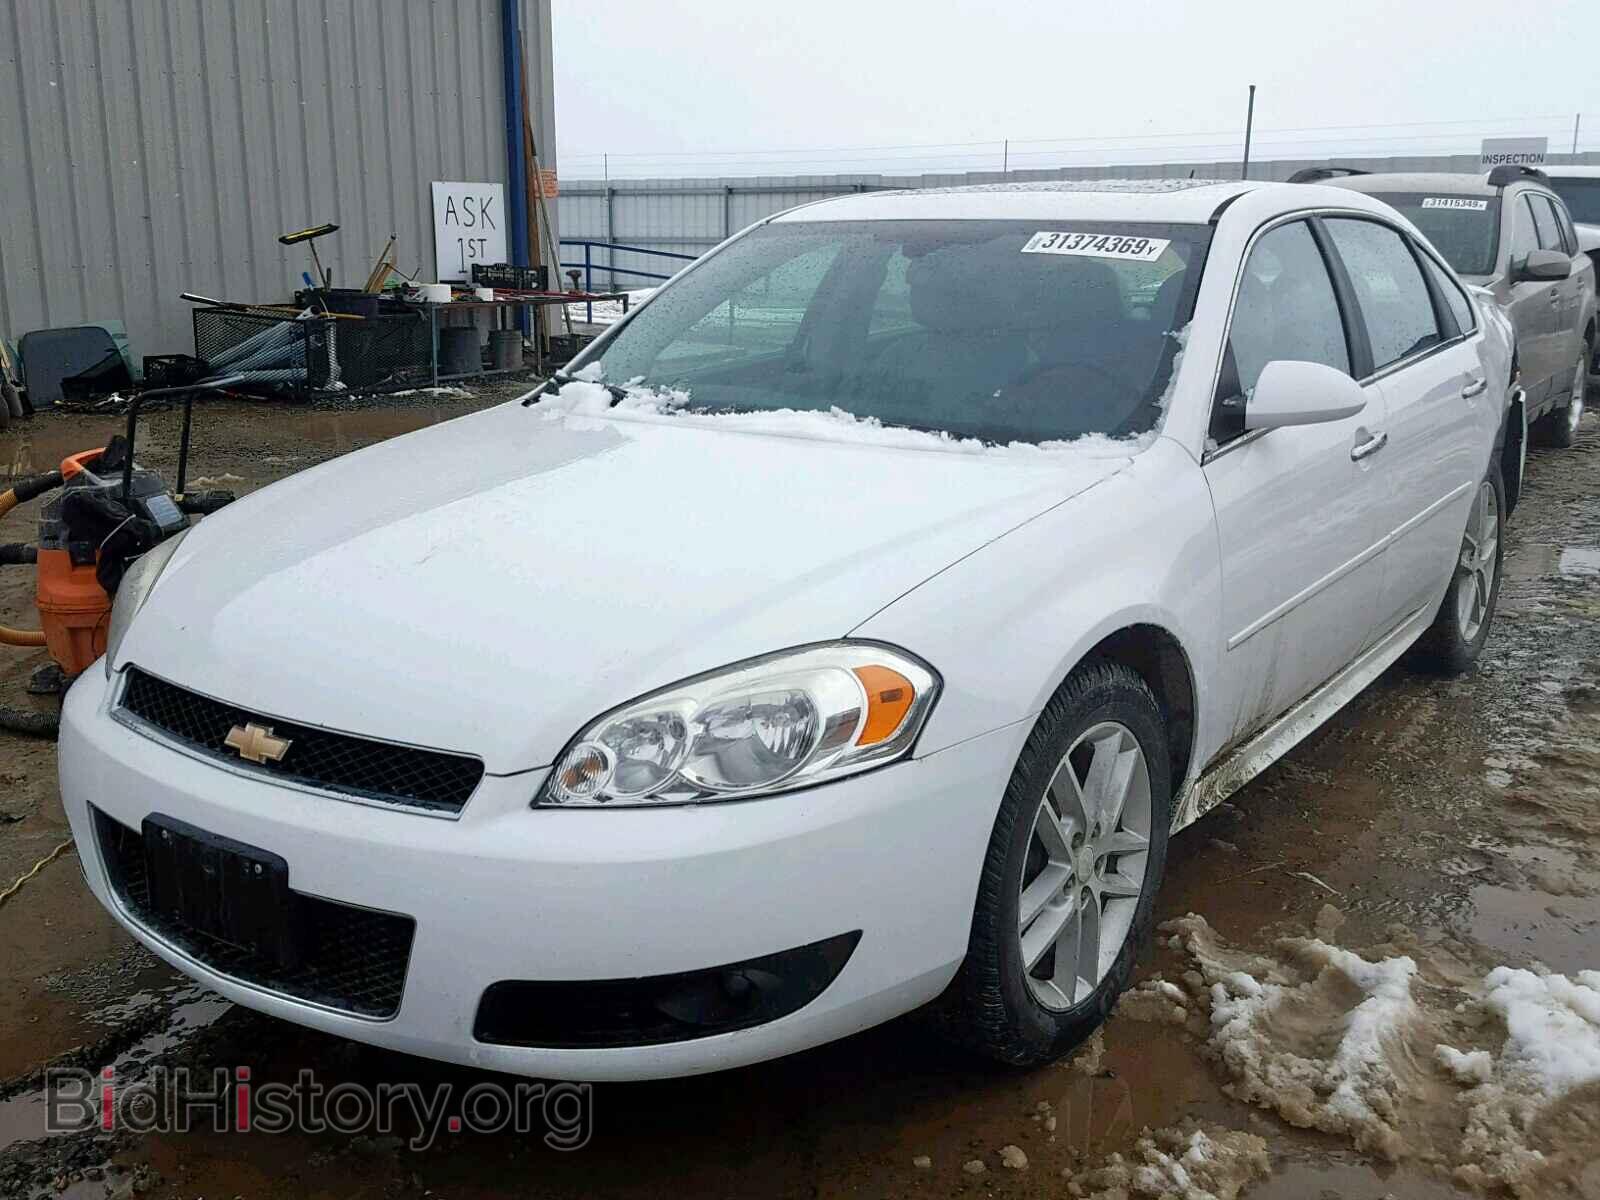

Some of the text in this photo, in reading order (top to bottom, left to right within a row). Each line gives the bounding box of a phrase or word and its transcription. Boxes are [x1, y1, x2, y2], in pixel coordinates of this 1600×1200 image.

[1482, 153, 1544, 165] INSPECTION
[445, 195, 496, 230] ASK
[457, 238, 487, 274] 1ST
